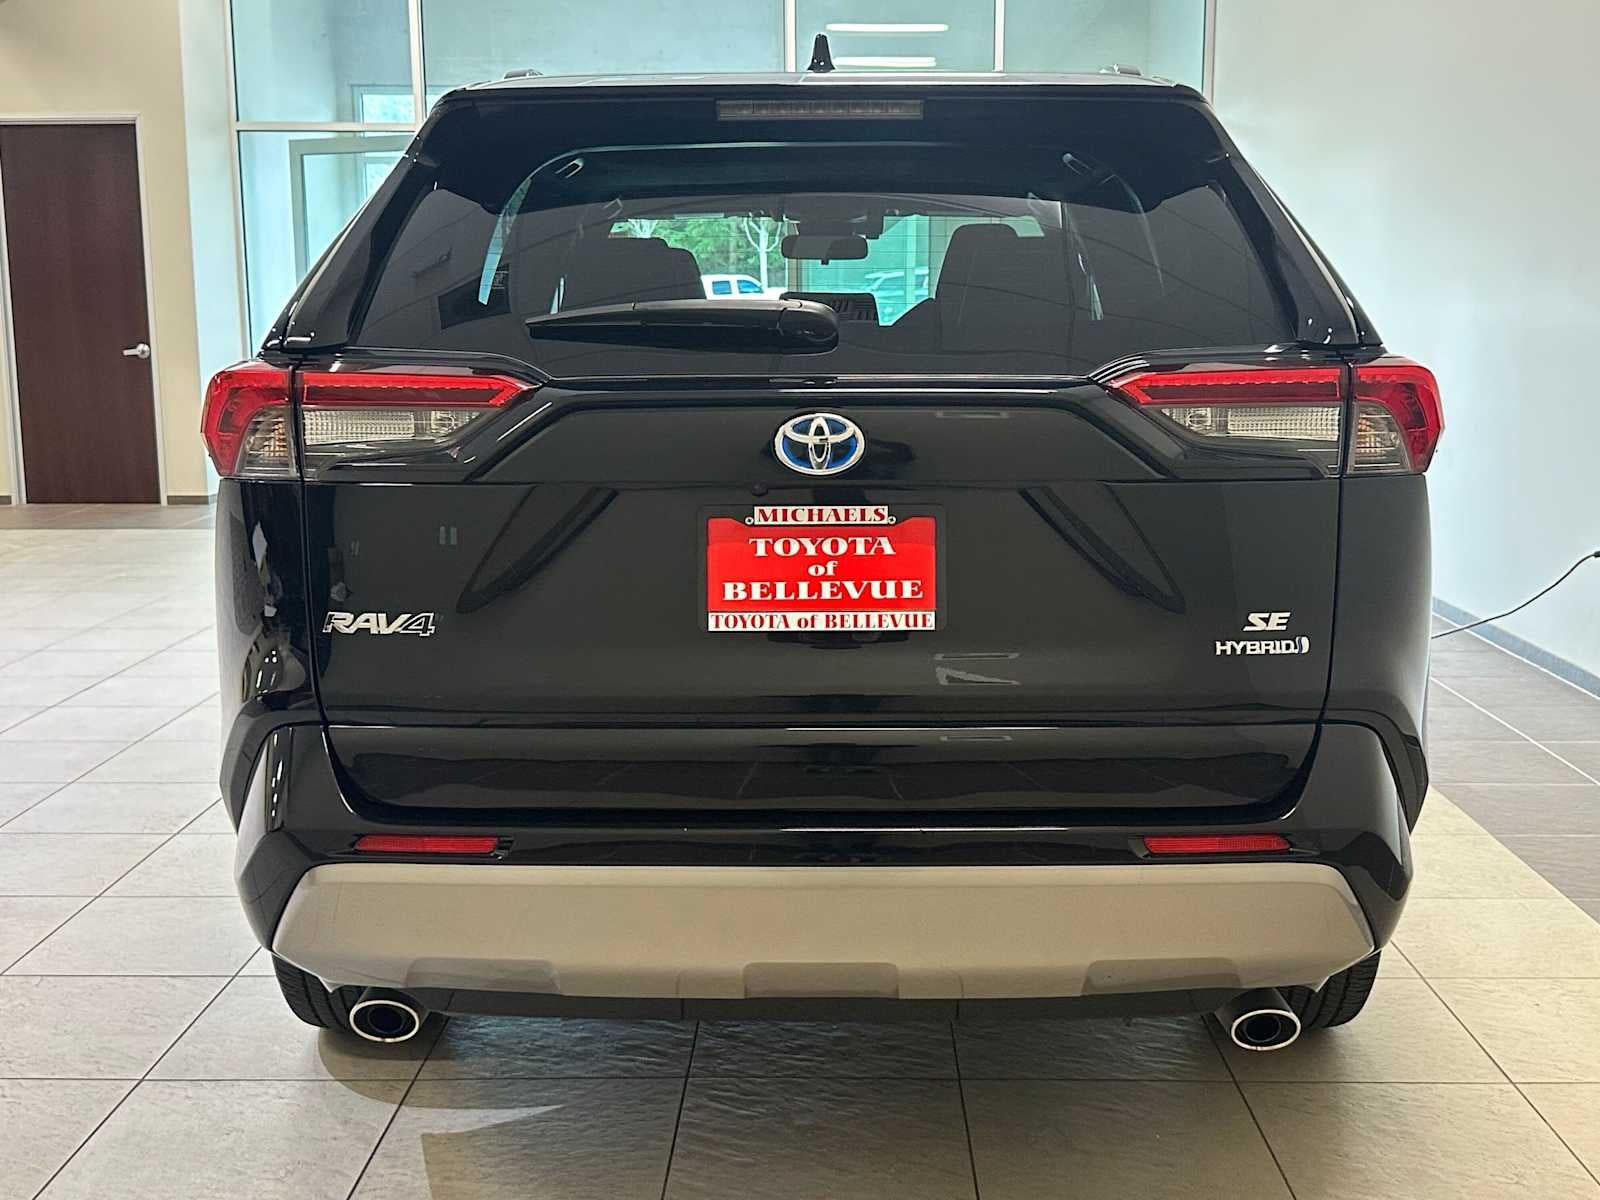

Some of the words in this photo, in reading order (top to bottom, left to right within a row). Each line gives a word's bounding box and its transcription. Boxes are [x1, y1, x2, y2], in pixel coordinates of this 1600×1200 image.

[758, 507, 886, 523] MICHAELS
[749, 536, 896, 557] TOYOTA
[808, 560, 838, 576] of
[722, 580, 924, 601] BELLEVUE
[322, 611, 436, 637] RAV4
[711, 614, 789, 629] TOYOTA
[797, 614, 818, 629] of
[825, 613, 933, 629] BELLEVUE
[1243, 612, 1291, 631] SE
[1215, 640, 1297, 655] HYBRID
